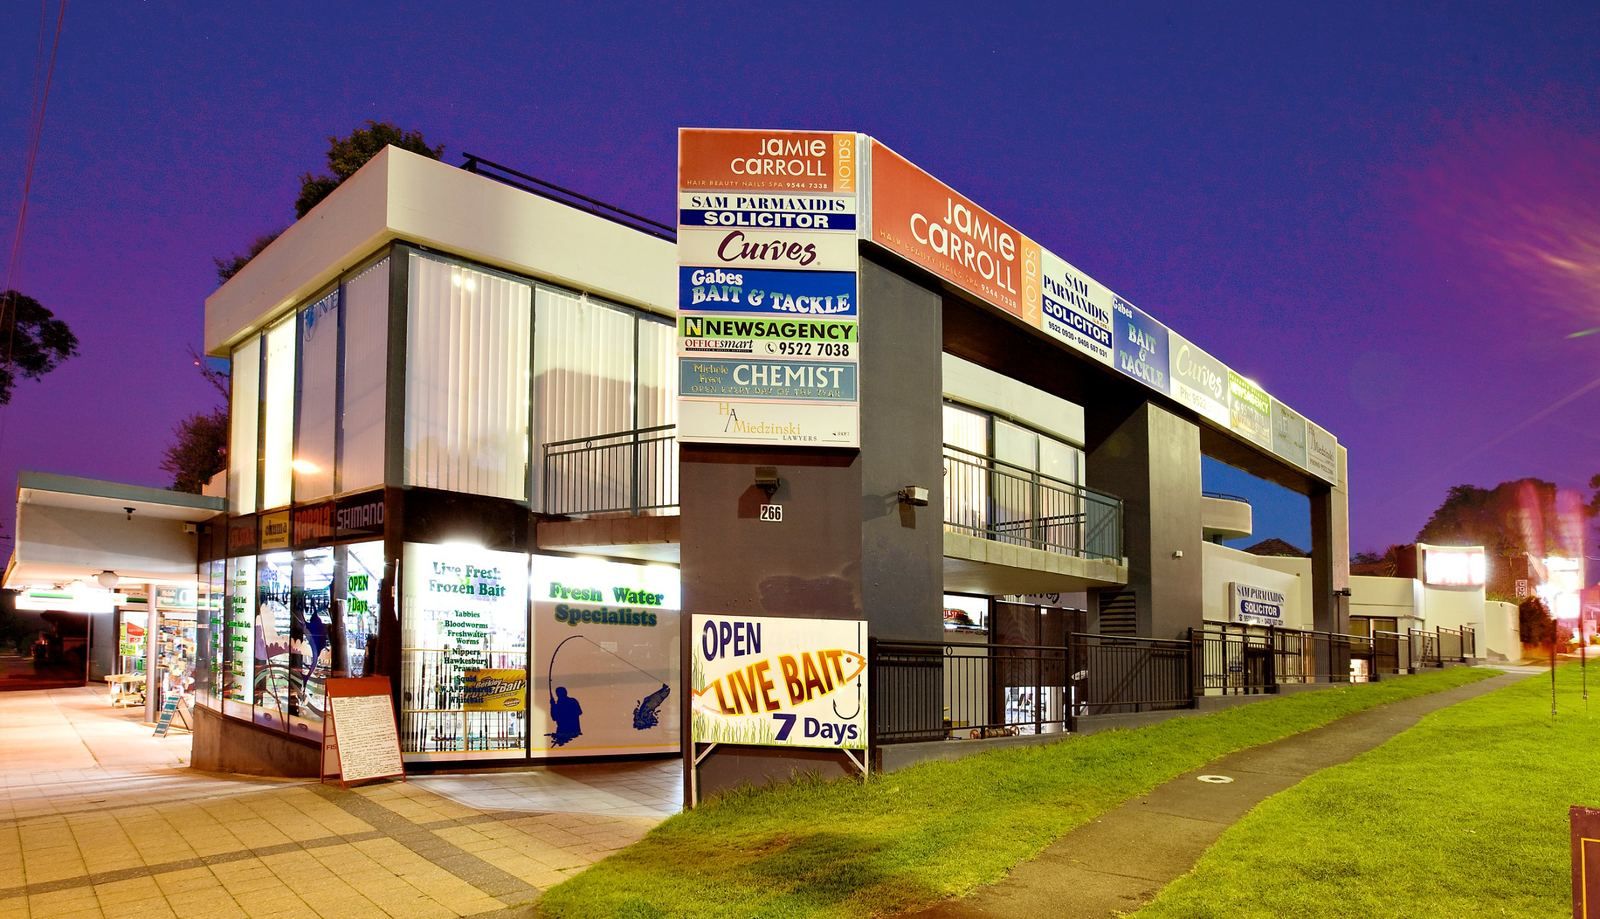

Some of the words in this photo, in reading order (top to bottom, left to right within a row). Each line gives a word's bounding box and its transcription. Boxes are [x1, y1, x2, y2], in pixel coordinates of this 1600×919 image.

[692, 196, 728, 208] SAM
[736, 197, 846, 212] PARMAXIDIS
[704, 212, 829, 228] SOLICITOR
[717, 230, 817, 266] Curves
[692, 269, 743, 286] Gabes
[1065, 272, 1088, 298] SAM
[981, 283, 998, 299] 9544
[1044, 274, 1109, 324] PARMAXIDIS
[692, 286, 742, 304] BAIT
[748, 289, 765, 306] &
[770, 292, 850, 314] TACKLE
[1113, 298, 1132, 318] Gabes
[1045, 298, 1110, 345] SOLICITOR
[1048, 321, 1060, 334] 9522
[706, 320, 854, 340] NEWSAGENCY
[1128, 322, 1156, 354] BAIT
[779, 342, 812, 356] 9522
[817, 343, 850, 357] 7038
[1138, 348, 1146, 362] &
[732, 364, 844, 388] CHEMIST
[1120, 350, 1164, 388] TACKLE
[1176, 344, 1222, 400] Curves
[691, 386, 717, 394] OPEN
[718, 402, 730, 416] H
[724, 408, 738, 432] A
[733, 420, 800, 435] Miedzinski
[336, 502, 384, 530] SHIMANO
[762, 506, 781, 520] 266
[432, 562, 462, 576] Live
[348, 575, 368, 592] OPEN
[429, 580, 474, 595] Frozen
[478, 582, 506, 598] Bait
[549, 582, 603, 602] Fresh
[612, 586, 664, 606] Water
[1237, 586, 1250, 598] SAM
[352, 598, 368, 614] Days
[454, 610, 481, 618] Yabbies
[1244, 602, 1278, 616] SOLICITOR
[555, 604, 657, 626] Specialists
[444, 620, 489, 630] Bloodworms
[447, 630, 488, 638] Freshwater
[456, 638, 480, 646] Worms
[702, 620, 762, 662] OPEN
[452, 648, 481, 657] Nippers
[444, 656, 488, 667] Hawkesbury
[454, 664, 480, 672] Prawns
[714, 660, 780, 716] LIVE
[779, 650, 846, 706] BAIT
[772, 713, 797, 741] 7
[804, 717, 858, 745] Days
